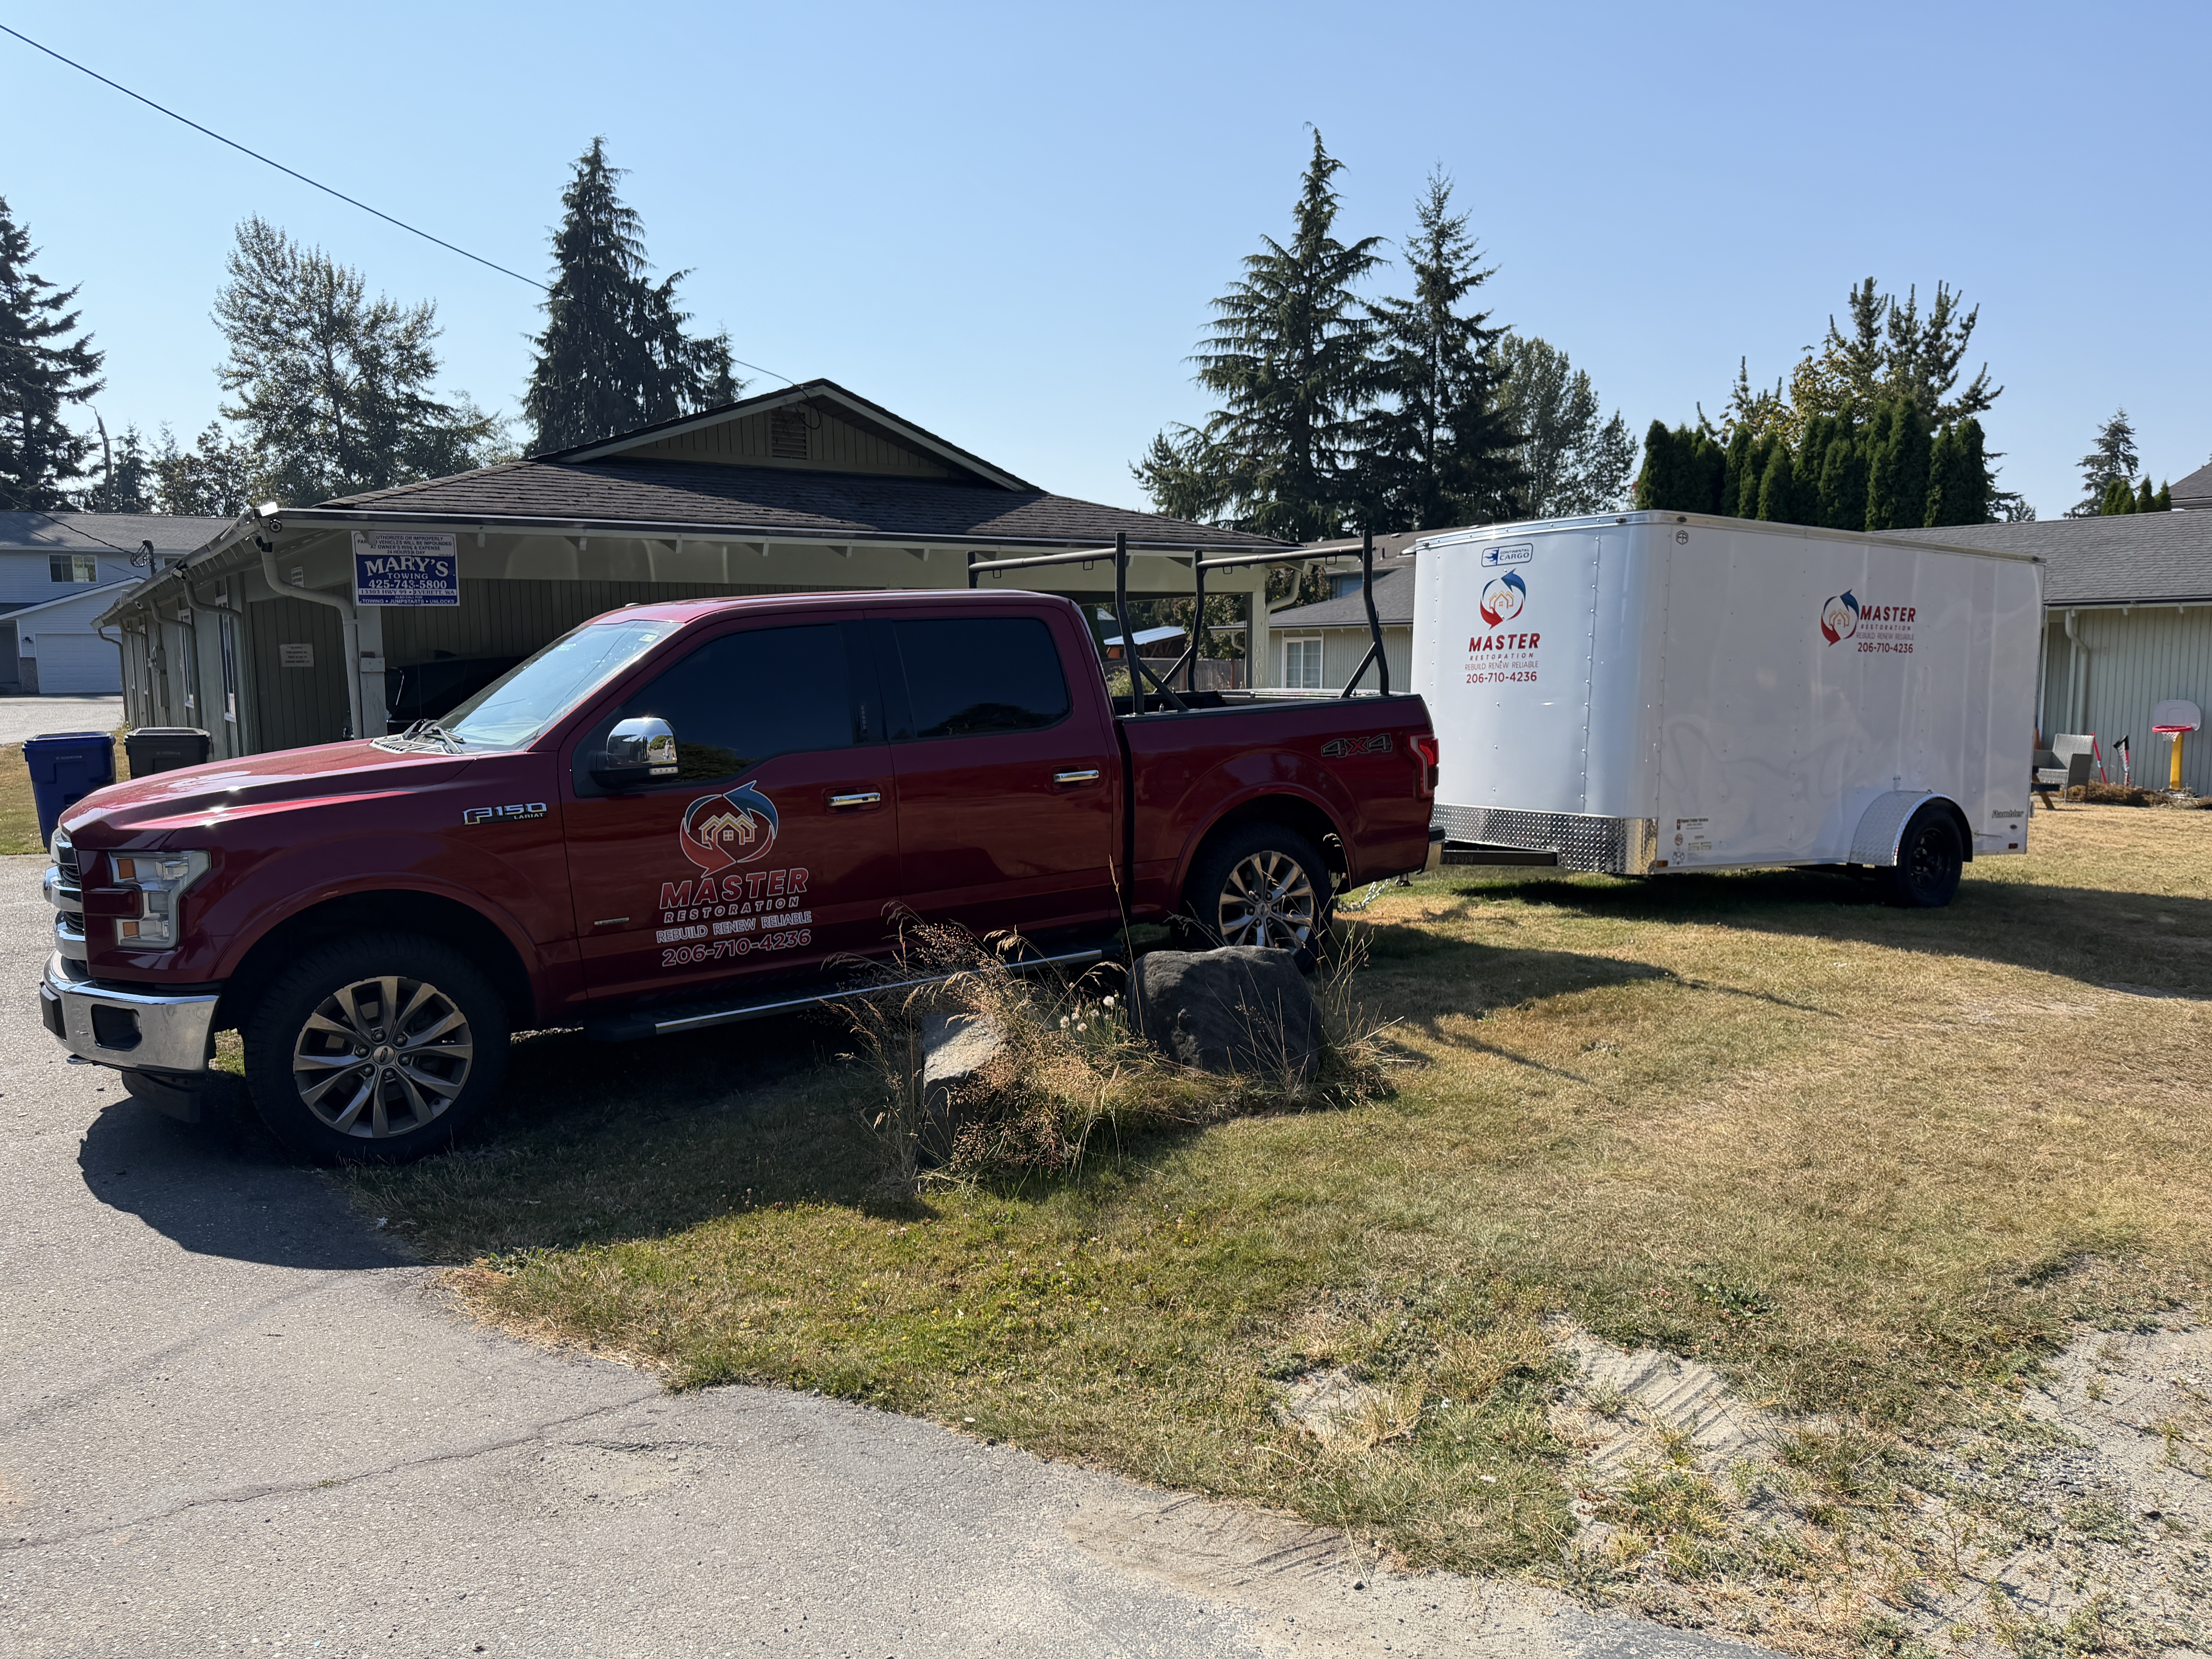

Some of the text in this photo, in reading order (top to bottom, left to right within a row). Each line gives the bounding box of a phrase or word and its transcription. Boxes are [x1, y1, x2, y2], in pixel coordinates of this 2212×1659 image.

[1499, 552, 1529, 560] CARGO
[364, 556, 448, 577] MARY'S
[368, 579, 447, 589] 425-743-5800
[1860, 605, 1916, 622] MASTER
[1468, 633, 1540, 652] MASTER
[1858, 642, 1913, 653] 206-710-4236
[1465, 660, 1539, 671] REBUILD RENEW RELIABLE
[1470, 653, 1534, 661] RESTORATION
[1466, 671, 1537, 684] 206-710-4236
[659, 867, 809, 910] MASTER
[664, 896, 800, 923] RESTORATION
[656, 911, 813, 943] REBUILD RENEW RELIABLE
[662, 929, 812, 967] 206-710-4236
